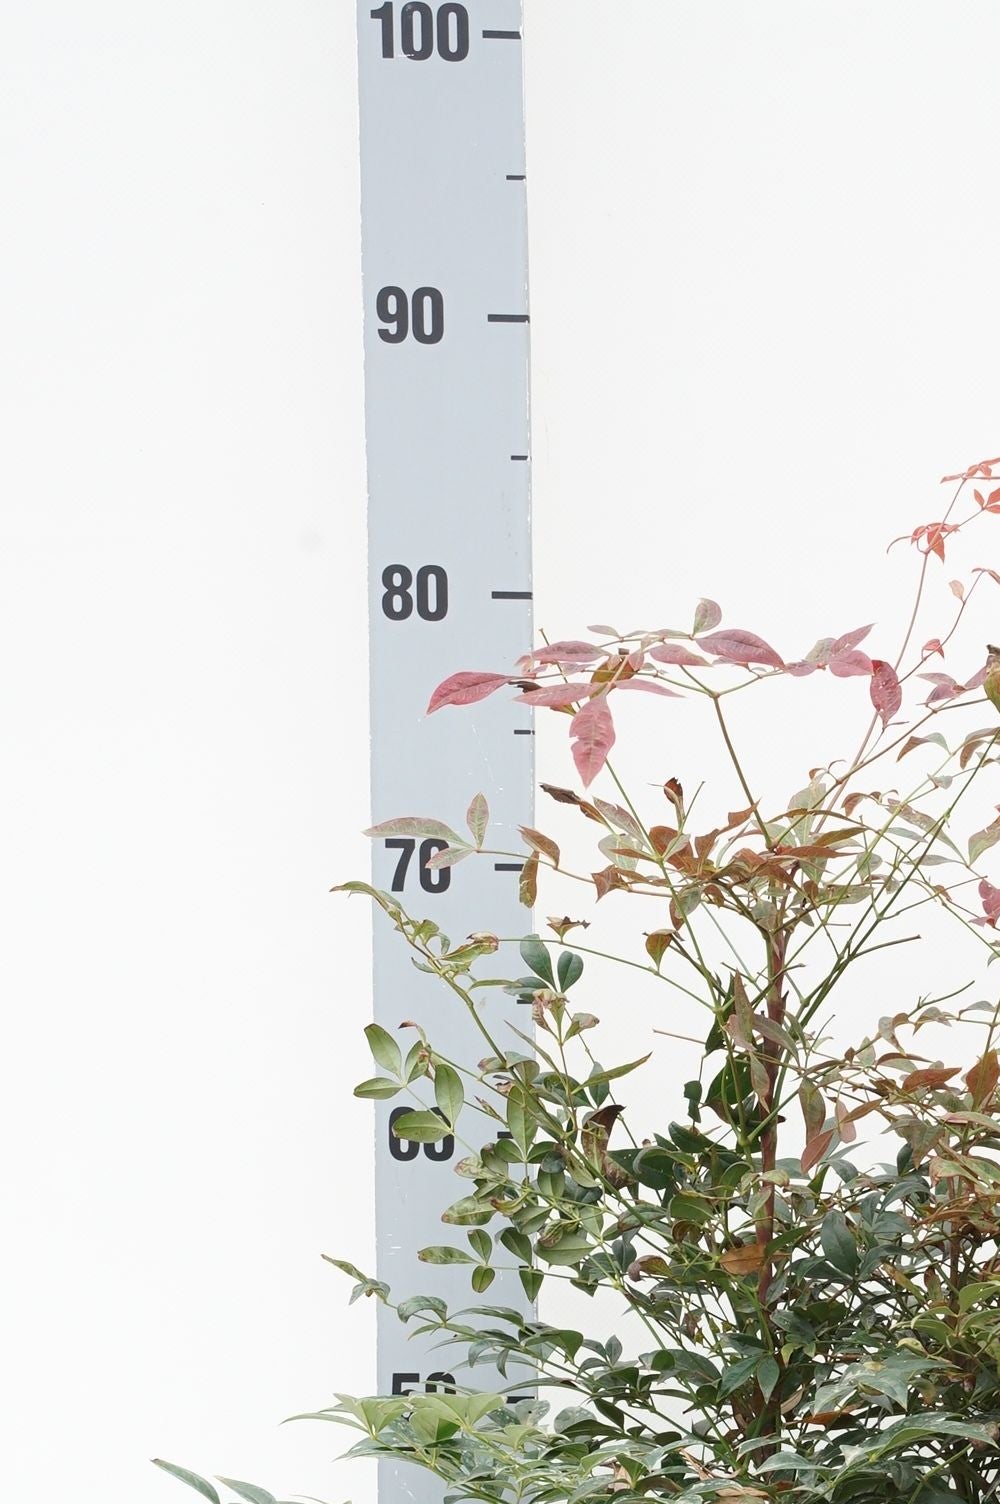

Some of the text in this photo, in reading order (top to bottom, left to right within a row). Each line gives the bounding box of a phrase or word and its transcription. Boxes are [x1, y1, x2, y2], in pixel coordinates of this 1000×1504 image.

[371, 2, 470, 62] 100
[377, 286, 444, 345] 90
[381, 564, 449, 622] 80
[384, 838, 451, 893] 70
